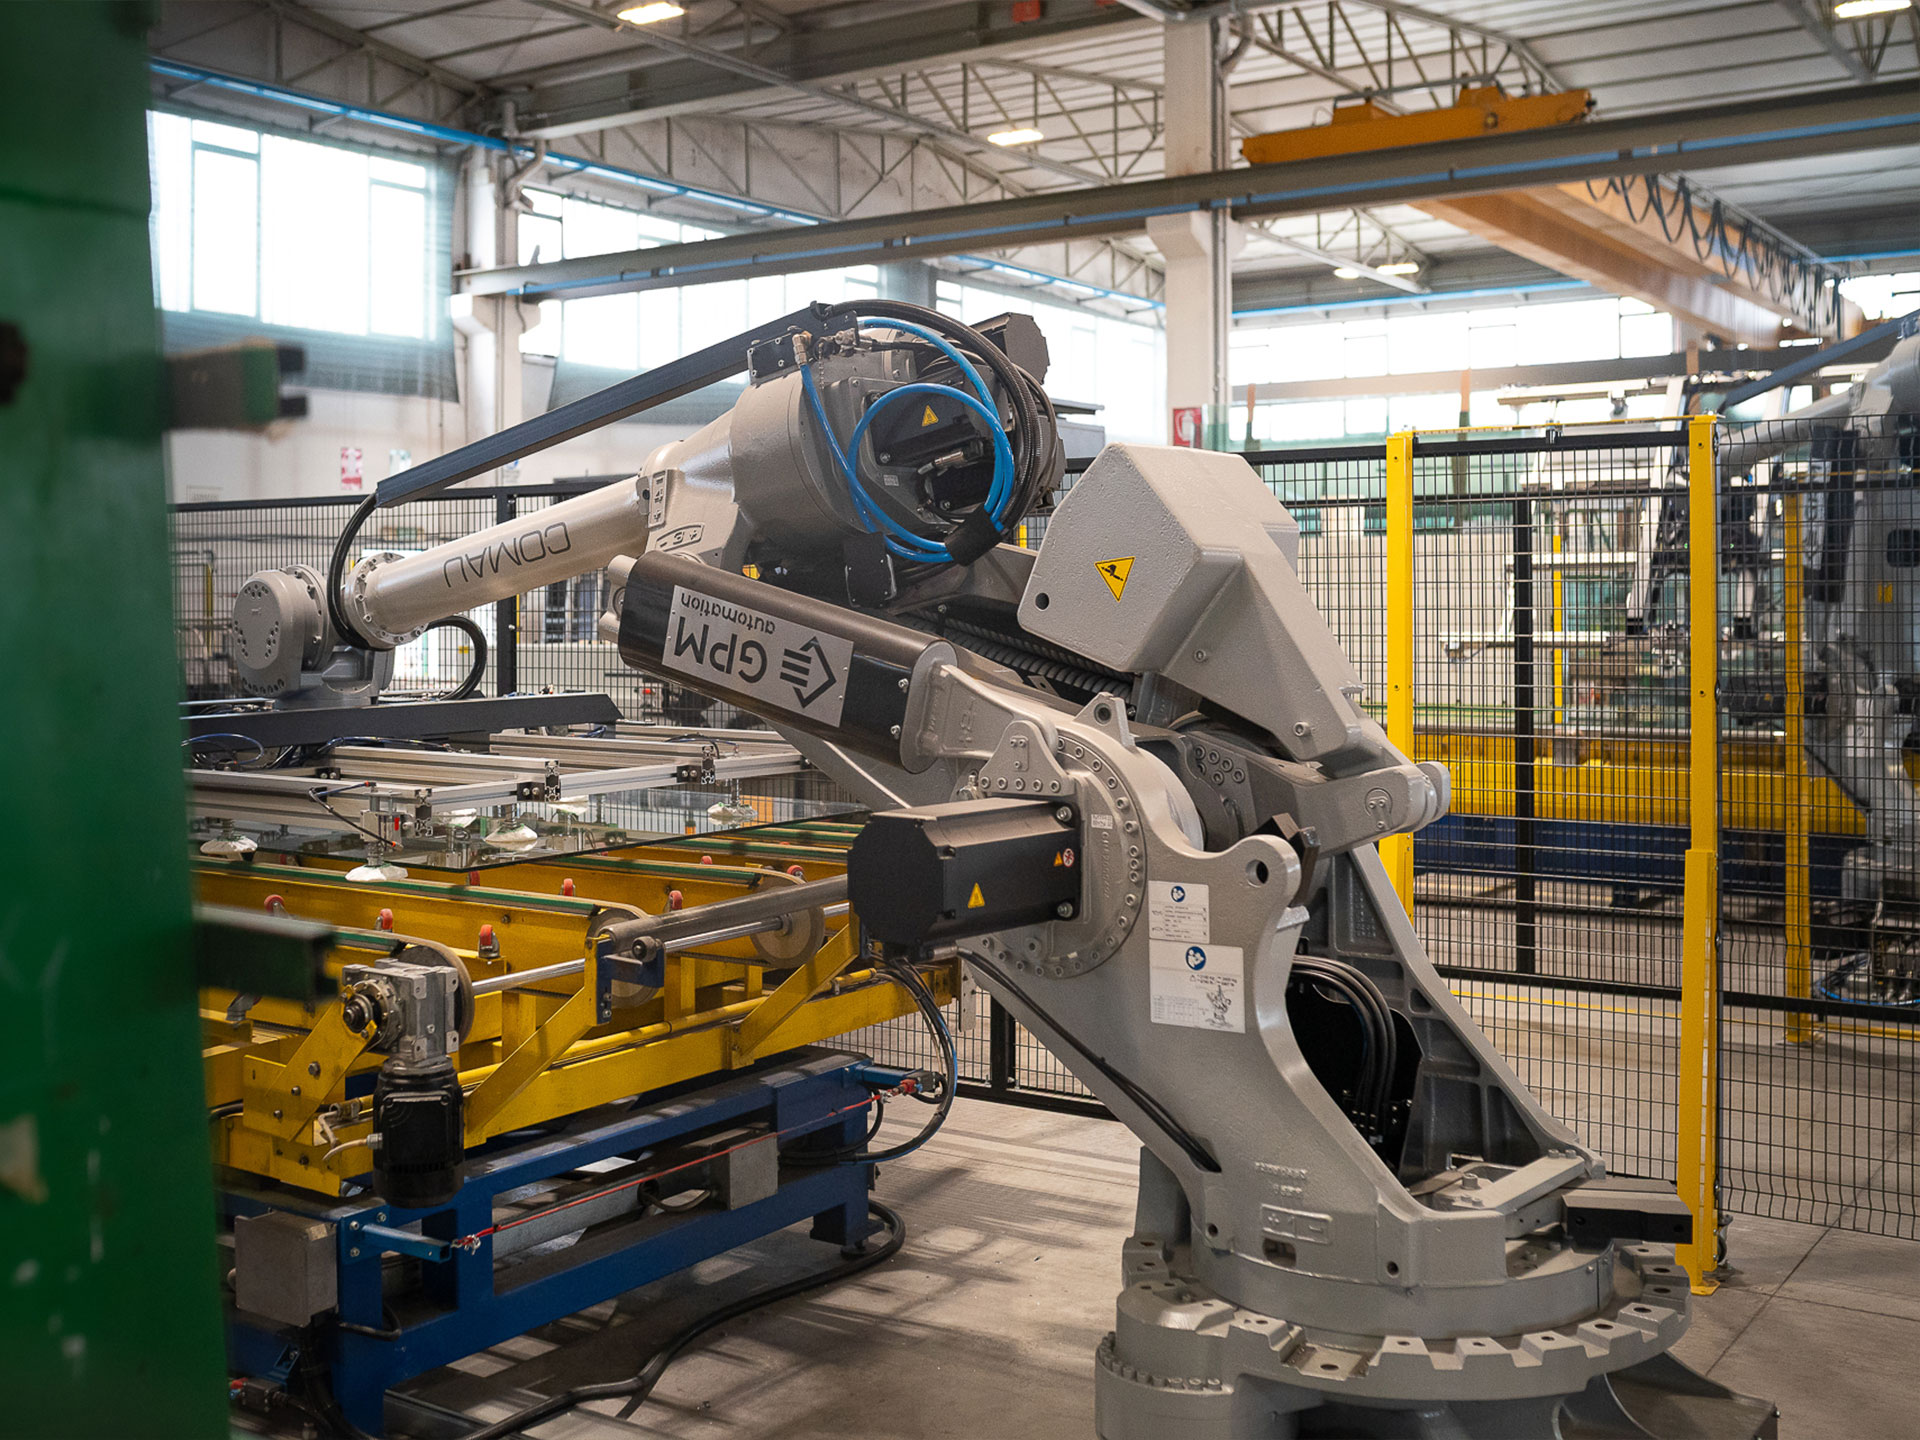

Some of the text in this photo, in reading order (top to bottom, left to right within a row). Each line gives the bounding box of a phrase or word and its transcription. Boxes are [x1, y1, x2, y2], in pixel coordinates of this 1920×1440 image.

[443, 521, 571, 588] COMAU
[680, 592, 776, 635] automation
[674, 616, 768, 684] GPM
